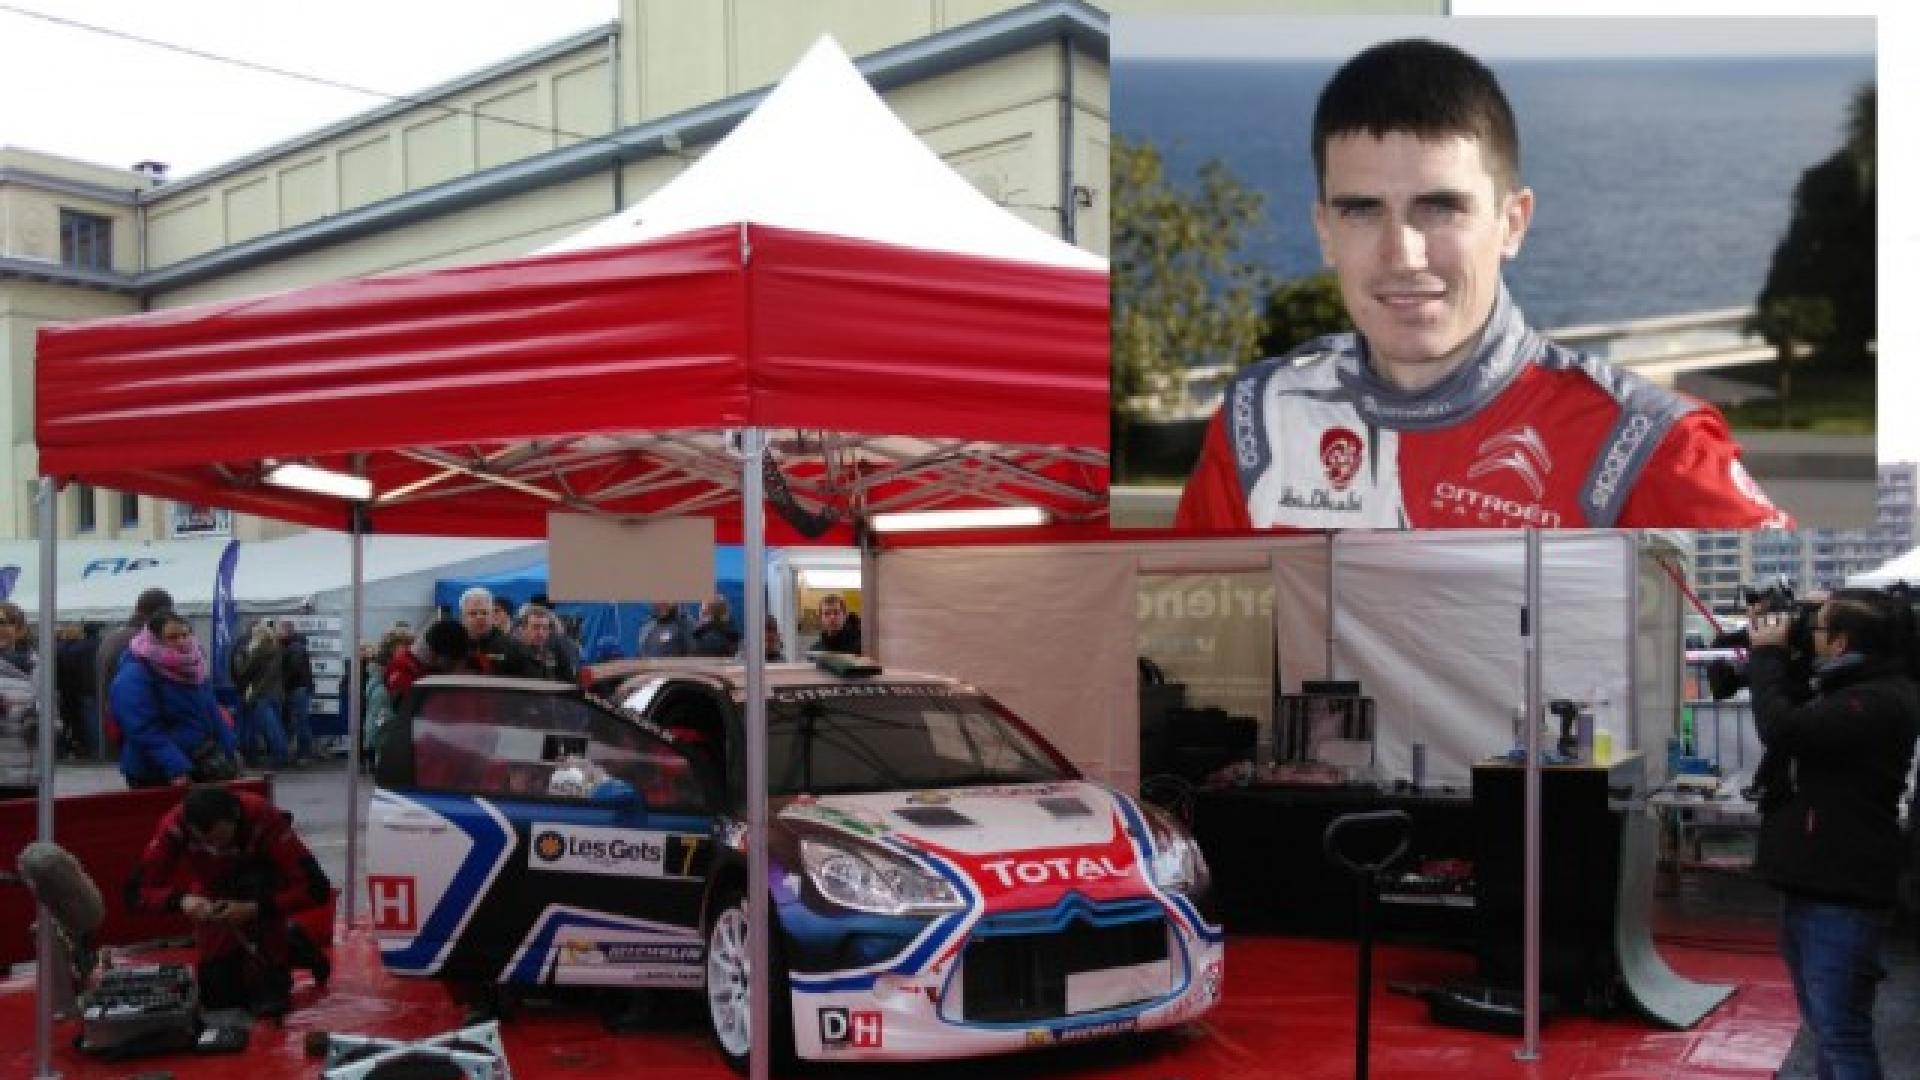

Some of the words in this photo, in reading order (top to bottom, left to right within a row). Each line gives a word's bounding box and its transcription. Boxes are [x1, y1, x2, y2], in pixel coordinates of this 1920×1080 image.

[569, 834, 606, 858] Les
[609, 839, 661, 862] Gets
[680, 836, 698, 877] 7
[980, 857, 1129, 888] TOTAL
[373, 881, 409, 925] H
